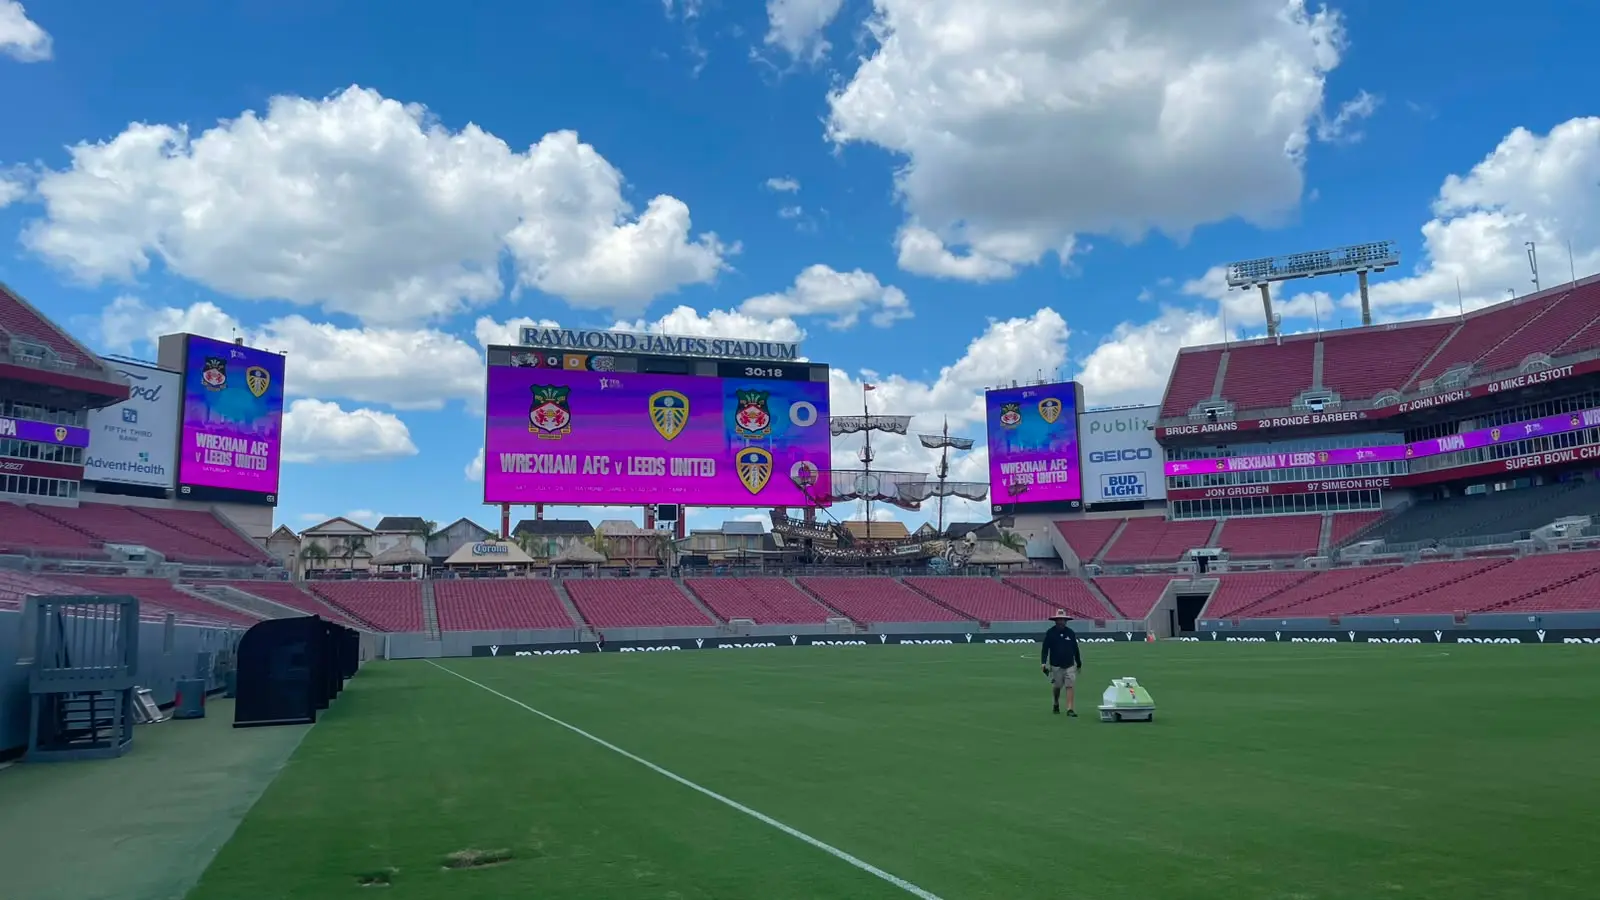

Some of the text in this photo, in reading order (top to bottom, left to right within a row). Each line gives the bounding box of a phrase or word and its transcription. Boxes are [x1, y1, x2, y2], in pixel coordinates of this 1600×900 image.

[523, 328, 797, 359] RAYMOND JAMES STADIUM
[745, 367, 783, 377] 30:18
[1487, 365, 1574, 393] 40 MIKE ALSTOTT
[1398, 390, 1464, 413] 47 JOHN LYNCH
[789, 401, 818, 427] 0
[1259, 411, 1358, 428] 20 RONDÉ BARBER
[104, 425, 153, 438] FIFTH THIRD
[1090, 417, 1149, 434] Publix
[1165, 422, 1238, 436] BRUCE ARIANS
[196, 431, 269, 457] WREXHAM AFC
[1437, 435, 1464, 452] TAMPA
[204, 449, 232, 467] LEEDS
[235, 453, 268, 471] UNITED
[1089, 447, 1153, 463] GEICO
[1228, 452, 1316, 470] WREXHAM V LEEDS
[1505, 455, 1541, 471] SUPER
[1543, 449, 1578, 464] BOWL
[85, 456, 165, 476] AdventHealth
[500, 452, 577, 474] WREXHAM
[582, 455, 610, 475] AFC
[628, 456, 666, 476] LEEDS
[670, 457, 716, 477] UNITED
[1001, 458, 1068, 474] WREXHAM AFC
[1037, 470, 1068, 484] UNITED
[1108, 475, 1138, 486] BUD
[1307, 478, 1391, 491] 97 SIMEON RICE
[1103, 485, 1144, 496] LIGHT
[1205, 485, 1269, 497] JON GRUDEN
[472, 543, 508, 555] Corona
